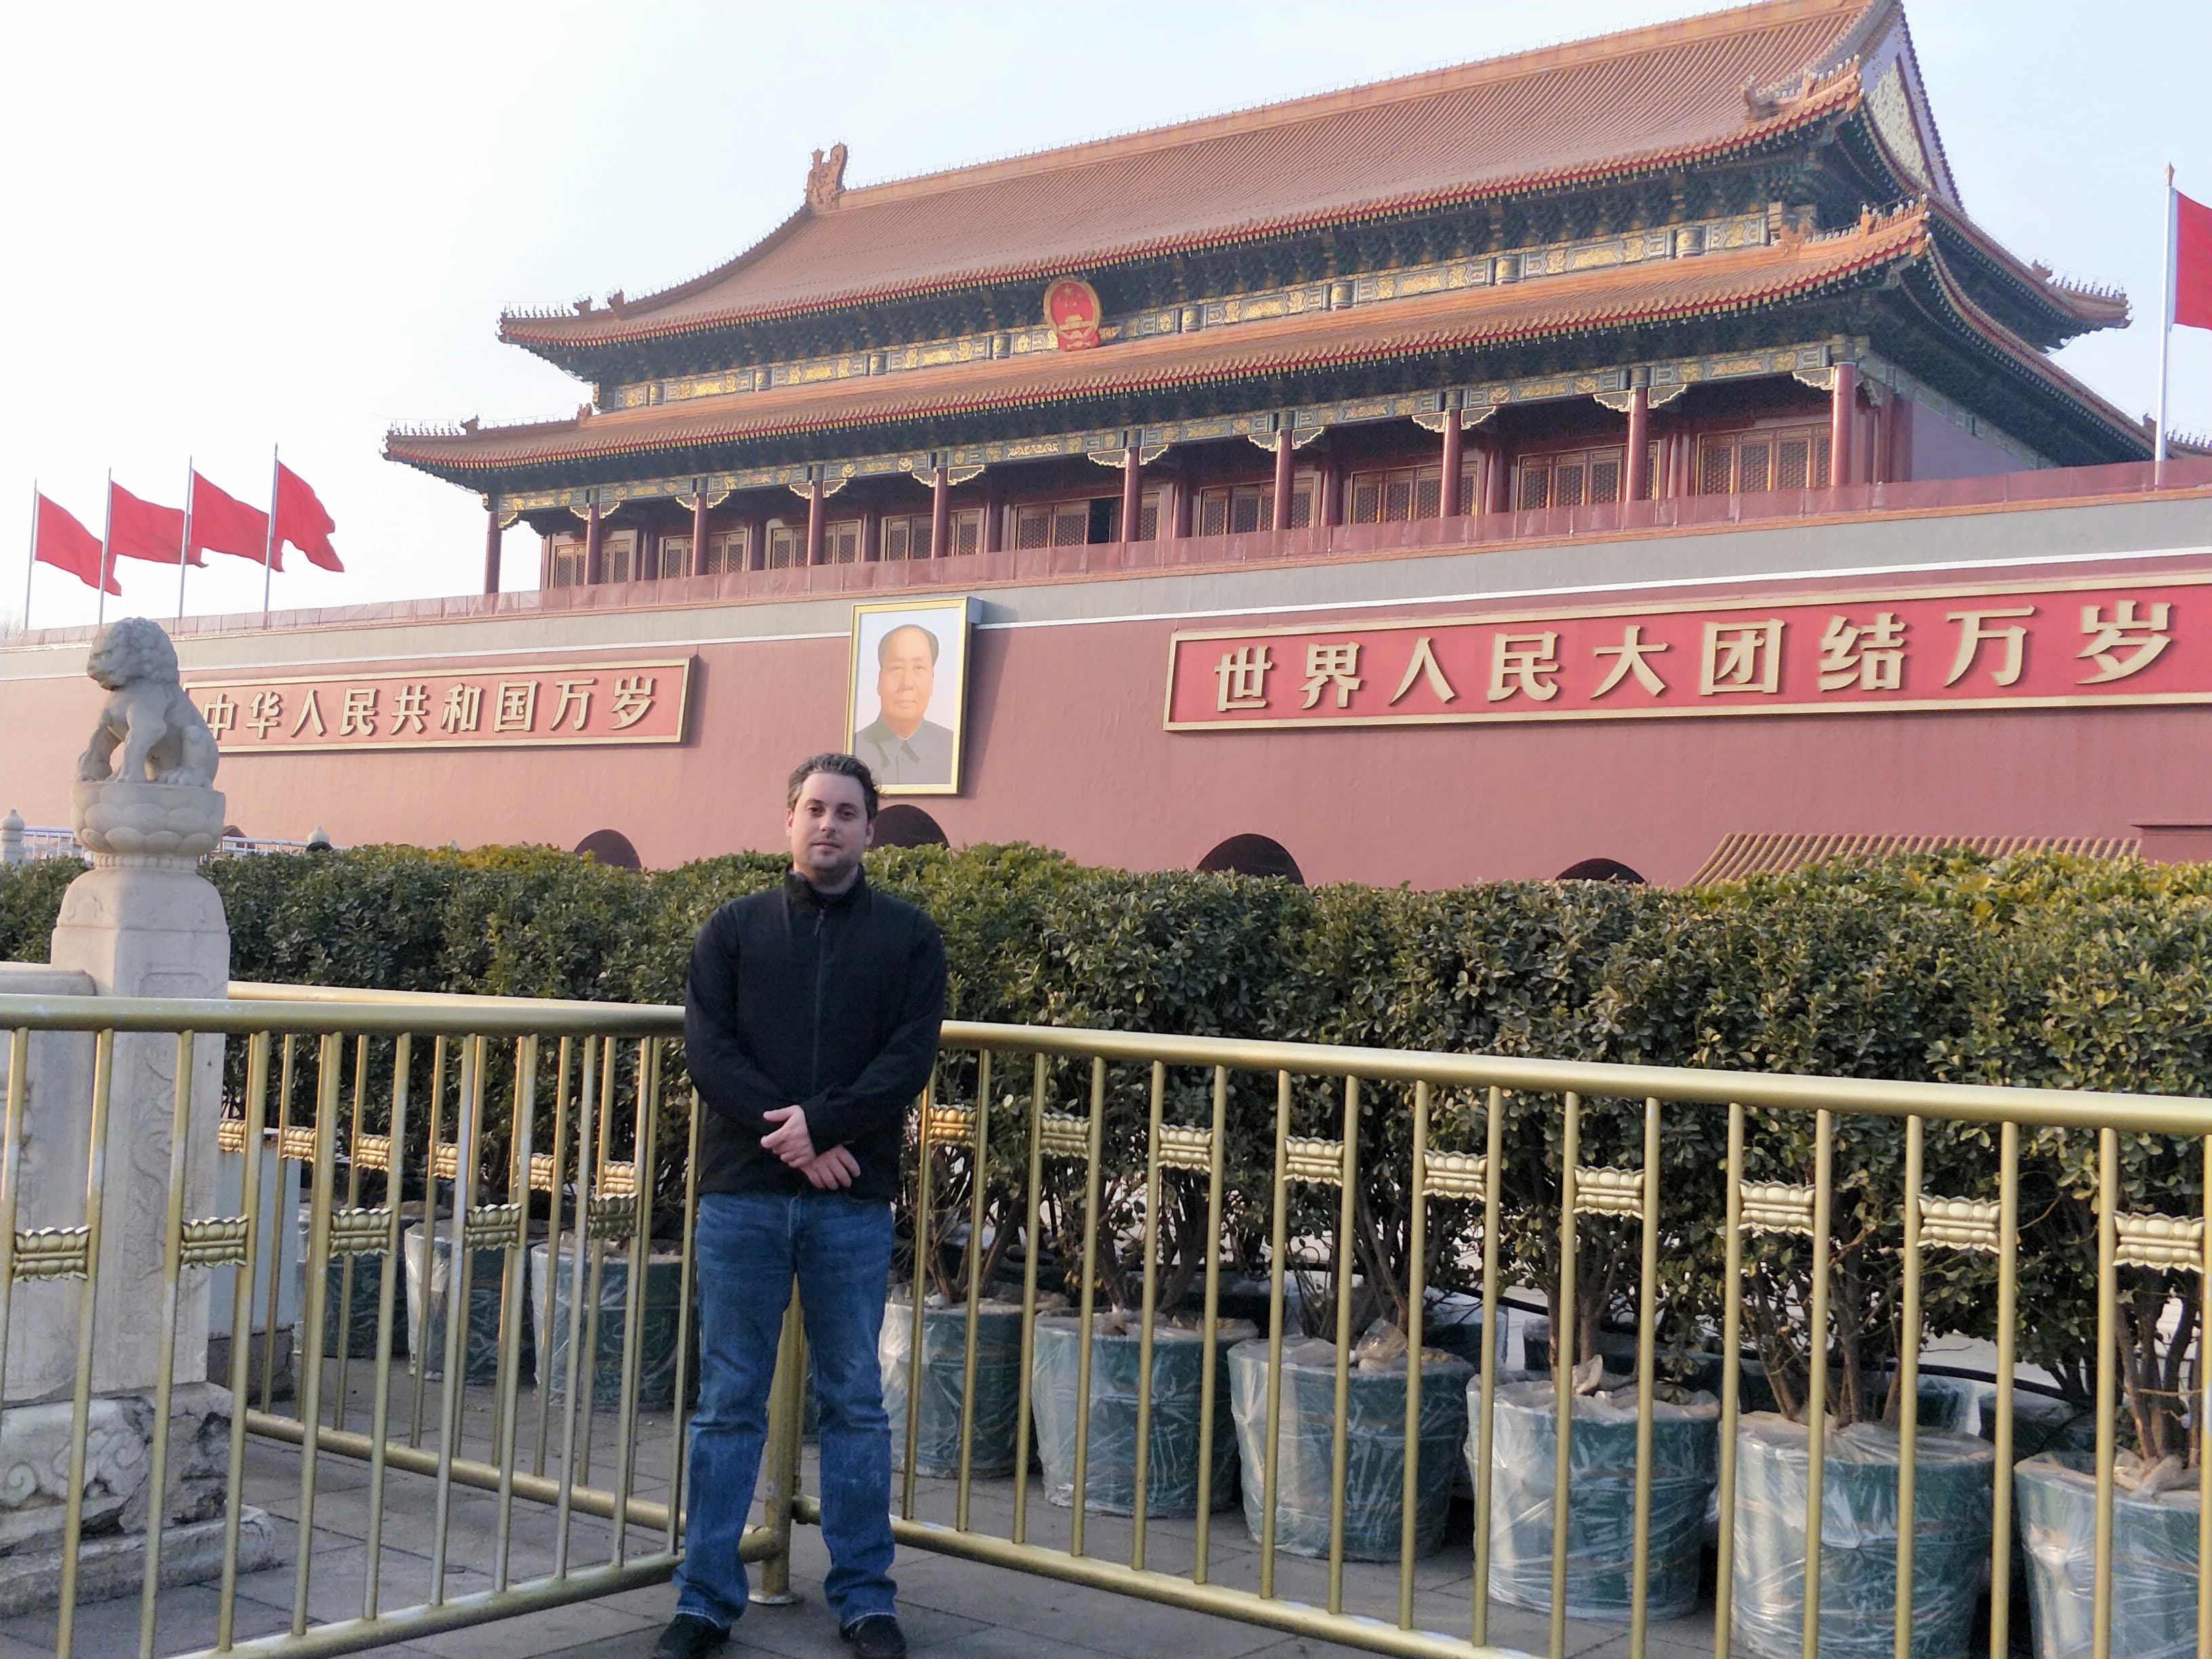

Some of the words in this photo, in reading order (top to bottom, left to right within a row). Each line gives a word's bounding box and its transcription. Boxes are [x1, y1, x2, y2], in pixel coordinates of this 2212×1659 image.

[1214, 599, 2171, 712] 世界人民大团结万岁
[204, 676, 656, 739] 中华人民共和国万岁
